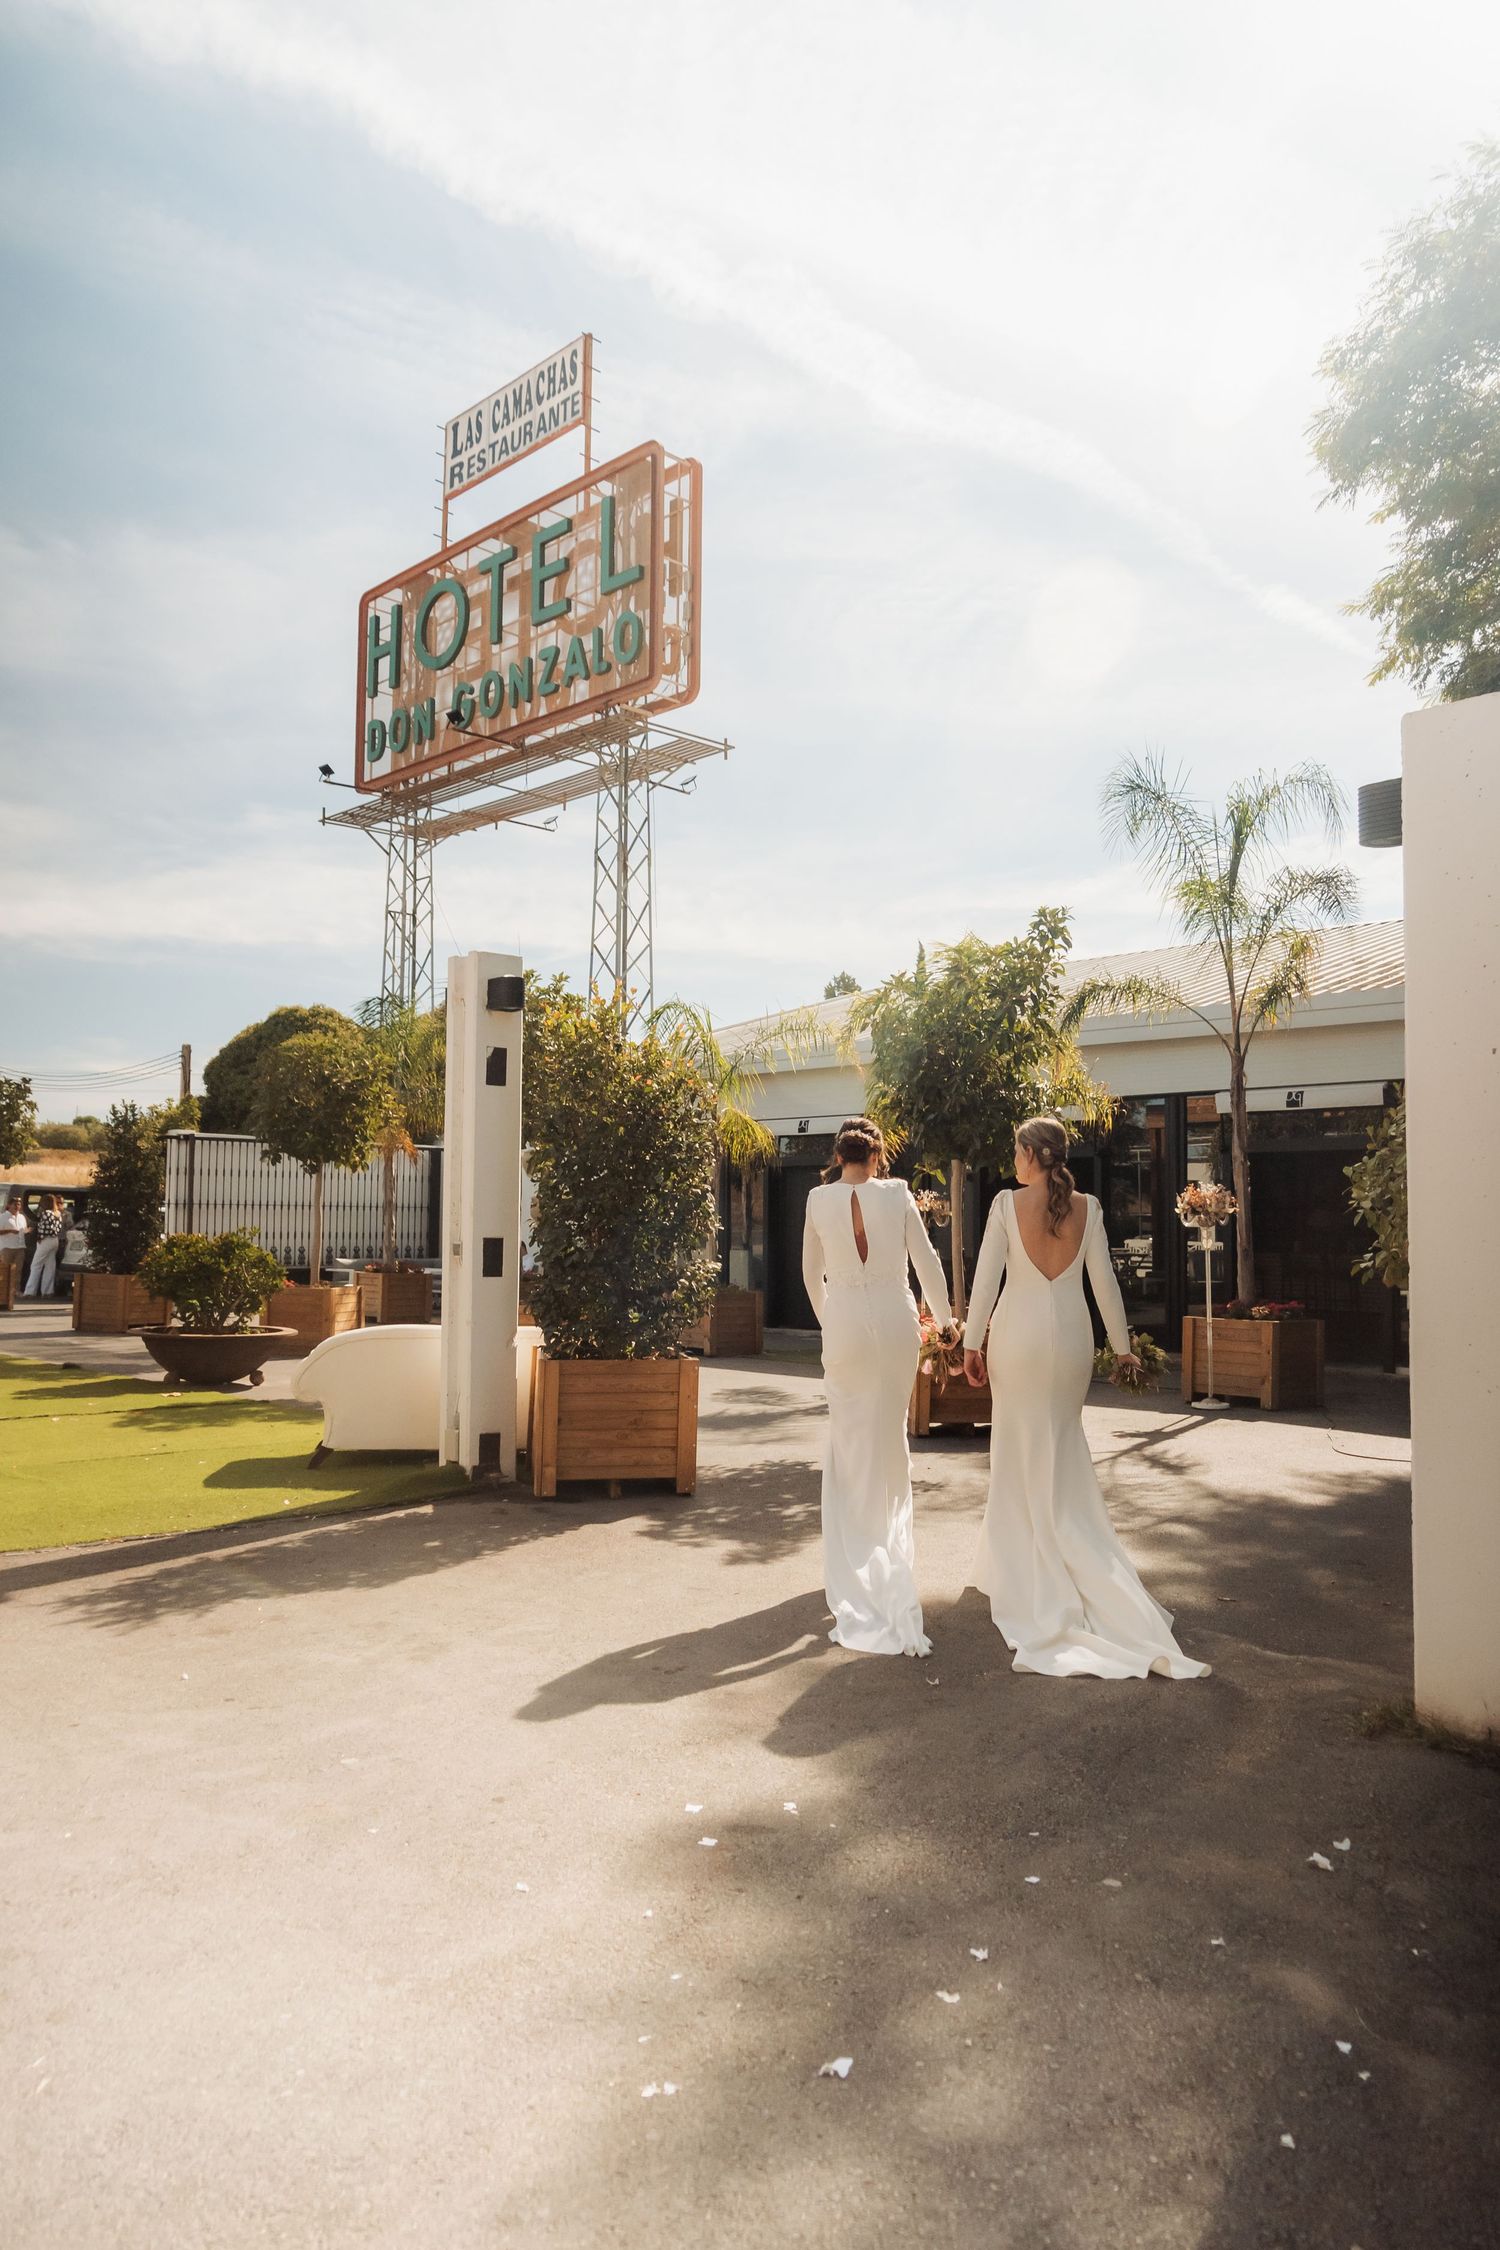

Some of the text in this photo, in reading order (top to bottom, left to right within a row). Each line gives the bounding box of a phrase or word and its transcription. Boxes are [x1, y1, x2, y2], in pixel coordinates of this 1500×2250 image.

[449, 390, 580, 490] RESTAURANTE
[451, 348, 578, 460] LAS CAMACHAS
[367, 495, 645, 699] HOTEL
[366, 610, 643, 763] DON GONZALO
